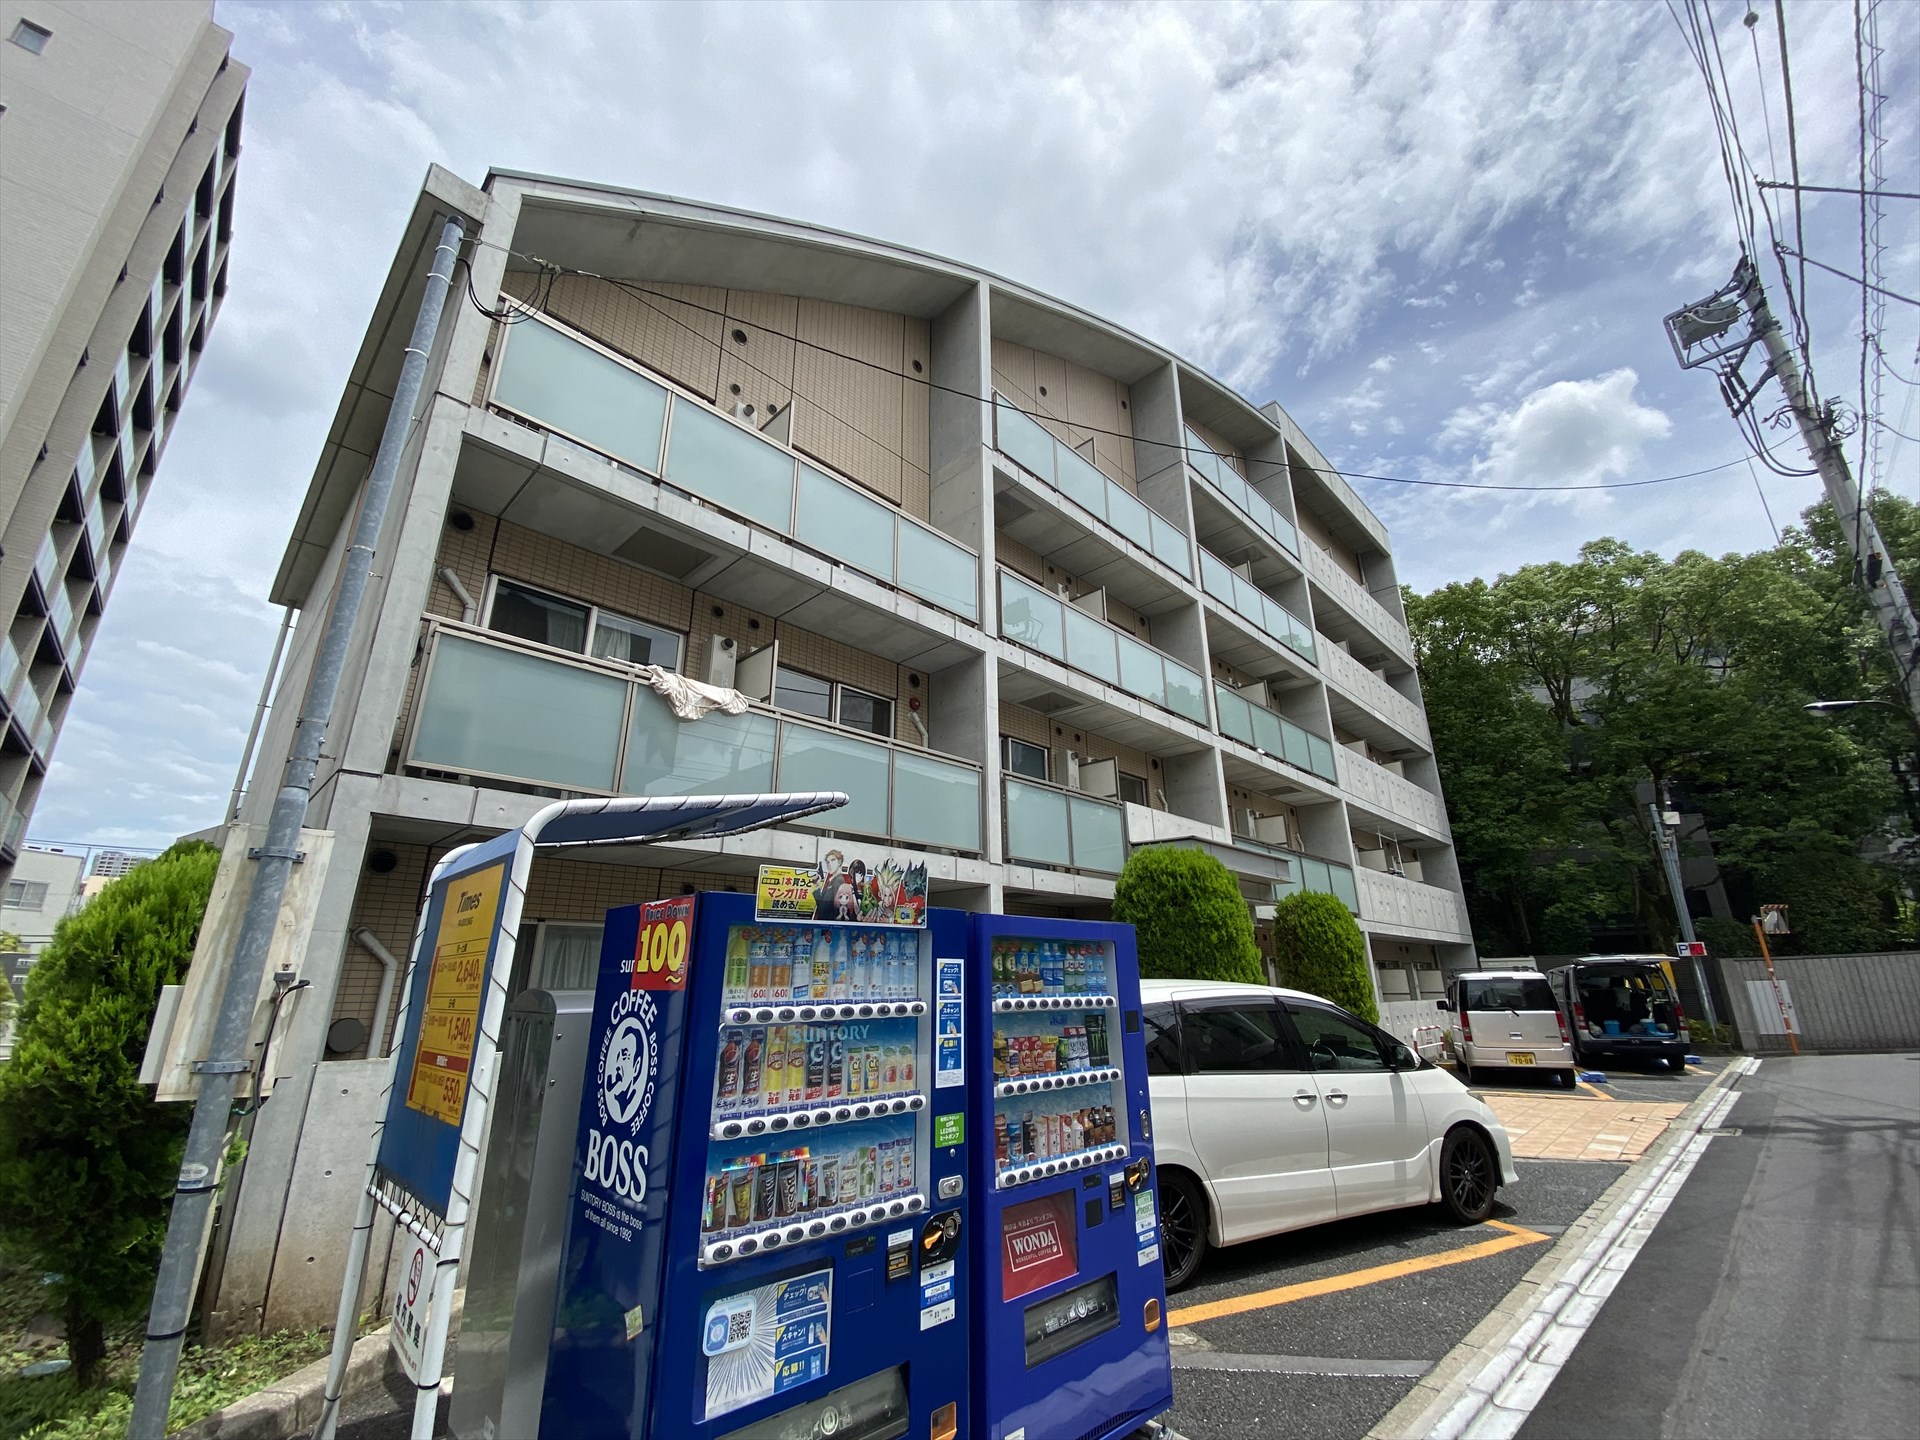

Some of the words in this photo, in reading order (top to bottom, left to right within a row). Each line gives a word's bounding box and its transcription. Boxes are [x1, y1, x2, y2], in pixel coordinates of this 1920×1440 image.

[457, 891, 482, 914] Times
[637, 921, 687, 973] 100
[1678, 944, 1688, 955] P
[611, 989, 657, 1030] COFFEE
[597, 1027, 612, 1084] COFFEE
[649, 1031, 658, 1076] BOSS
[597, 1088, 608, 1127] BOSS
[630, 1082, 655, 1137] COFFEE
[583, 1128, 649, 1203] BOSS
[580, 1189, 602, 1209] SUNTORY
[601, 1200, 617, 1218] BOSS
[616, 1207, 621, 1220] is
[621, 1209, 629, 1224] the
[629, 1213, 643, 1230] boss
[584, 1208, 591, 1219] of
[590, 1210, 600, 1224] them
[605, 1219, 619, 1236] since
[619, 1227, 632, 1242] 1992
[1012, 1229, 1056, 1255] WONDA
